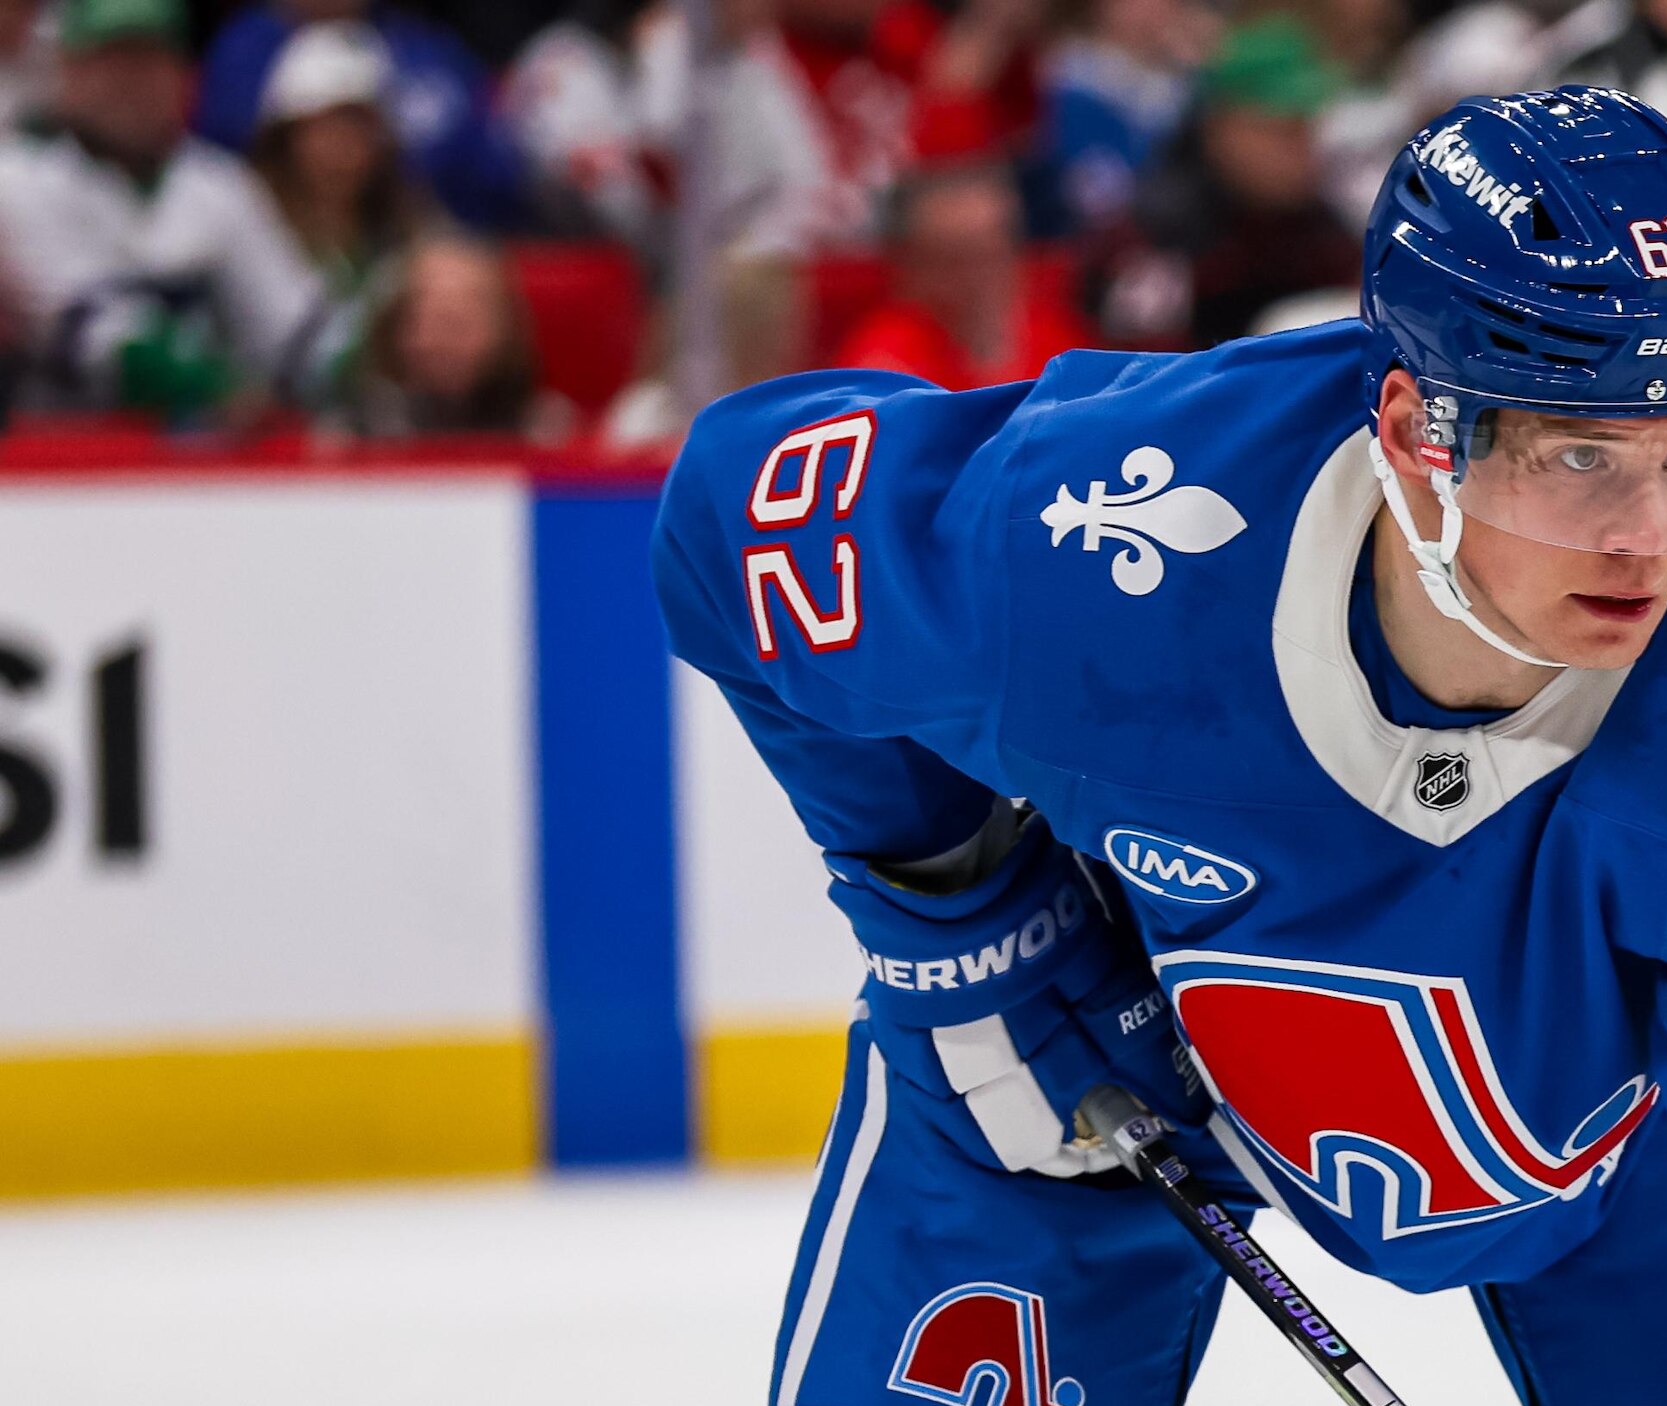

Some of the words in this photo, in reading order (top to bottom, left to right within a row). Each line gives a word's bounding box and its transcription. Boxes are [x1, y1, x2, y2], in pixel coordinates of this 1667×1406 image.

[1419, 124, 1533, 229] Kiewit
[742, 408, 877, 660] 62
[1426, 766, 1461, 799] NHL
[1127, 840, 1230, 892] IMA
[1118, 991, 1165, 1035] REK
[1127, 1123, 1151, 1142] 62
[1198, 1203, 1348, 1357] SHERWOOD
